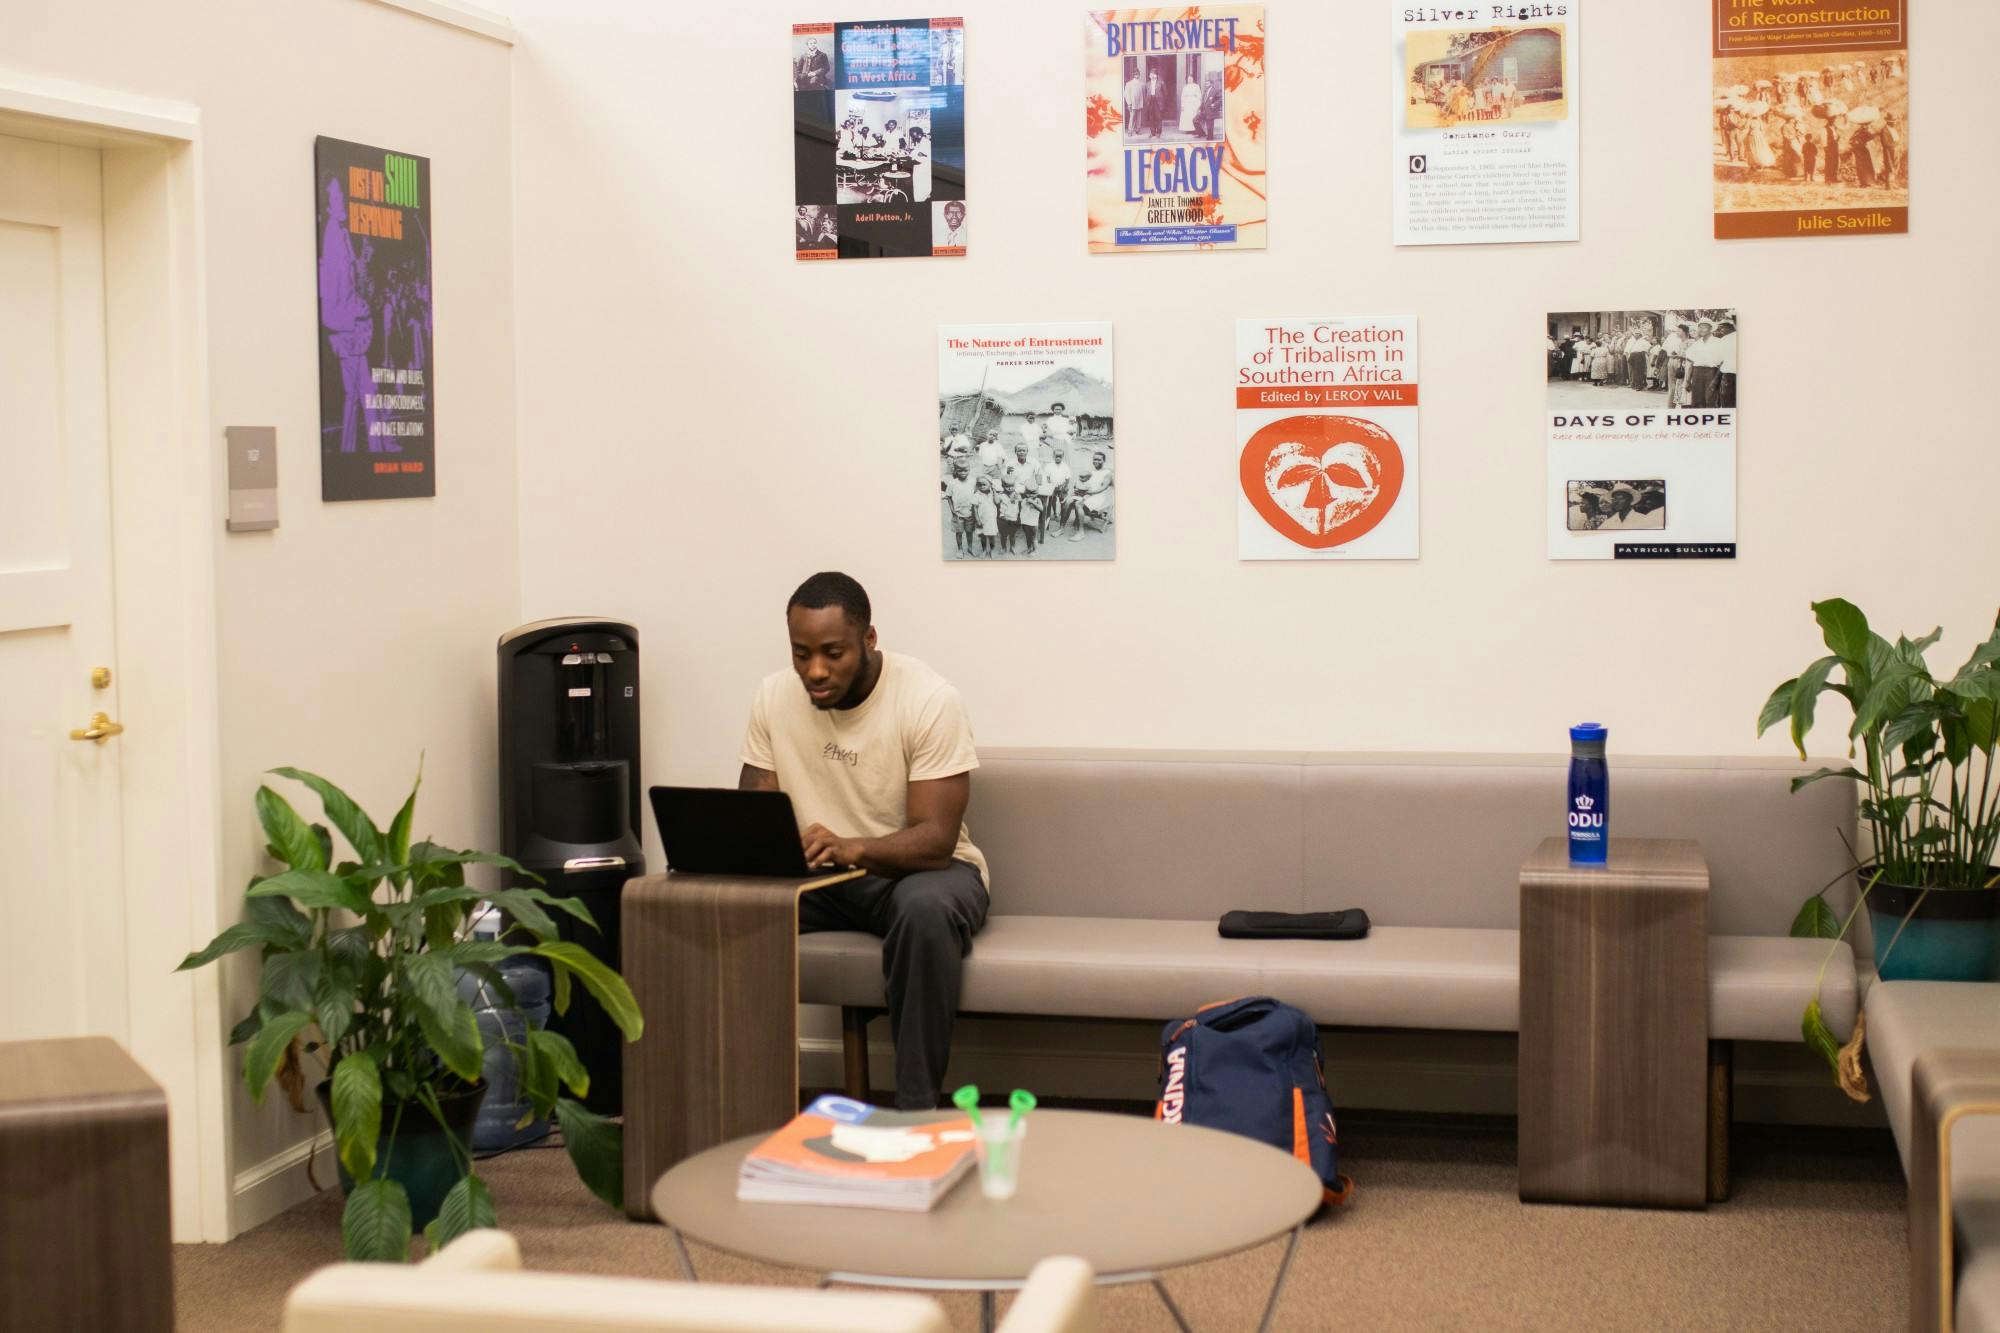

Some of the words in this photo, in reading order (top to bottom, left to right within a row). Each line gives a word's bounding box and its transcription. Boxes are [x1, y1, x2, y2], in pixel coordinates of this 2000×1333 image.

[1404, 8, 1479, 22] Silver
[1491, 3, 1568, 20] Rights
[1729, 11, 1747, 27] of
[1753, 6, 1891, 25] Reconstruction
[1107, 17, 1239, 58] BITTERSWEET
[848, 72, 859, 83] in
[860, 71, 886, 82] West
[888, 70, 917, 82] Africa
[385, 153, 420, 209] SOUL
[1124, 146, 1225, 202] LEGACY
[1147, 196, 1175, 209] JANETTE
[1177, 196, 1204, 207] THOMAS
[855, 213, 874, 222] Adell
[876, 213, 903, 222] Patton,
[904, 212, 914, 222] Jr.
[1147, 208, 1204, 224] GREENWOOD
[1797, 215, 1833, 231] Julie
[1836, 213, 1892, 228] Saville
[946, 338, 969, 349] The
[972, 338, 1011, 348] Nature
[1014, 337, 1026, 347] of
[1029, 337, 1103, 347] Entrustment
[1264, 327, 1305, 344] The
[1314, 325, 1404, 344] Creation
[1253, 347, 1274, 365] of
[1281, 346, 1376, 363] Tribalism
[1385, 345, 1404, 362] in
[1239, 366, 1334, 385] Southern
[1343, 365, 1403, 382] Africa
[1260, 391, 1300, 402] Edited
[1305, 391, 1321, 404] by
[1325, 390, 1369, 401] LEROY
[1373, 390, 1403, 400] VAIL
[1554, 415, 1615, 427] DAYS
[1626, 415, 1656, 426] OF
[1667, 414, 1731, 426] HOPE
[1569, 812, 1603, 828] ODU
